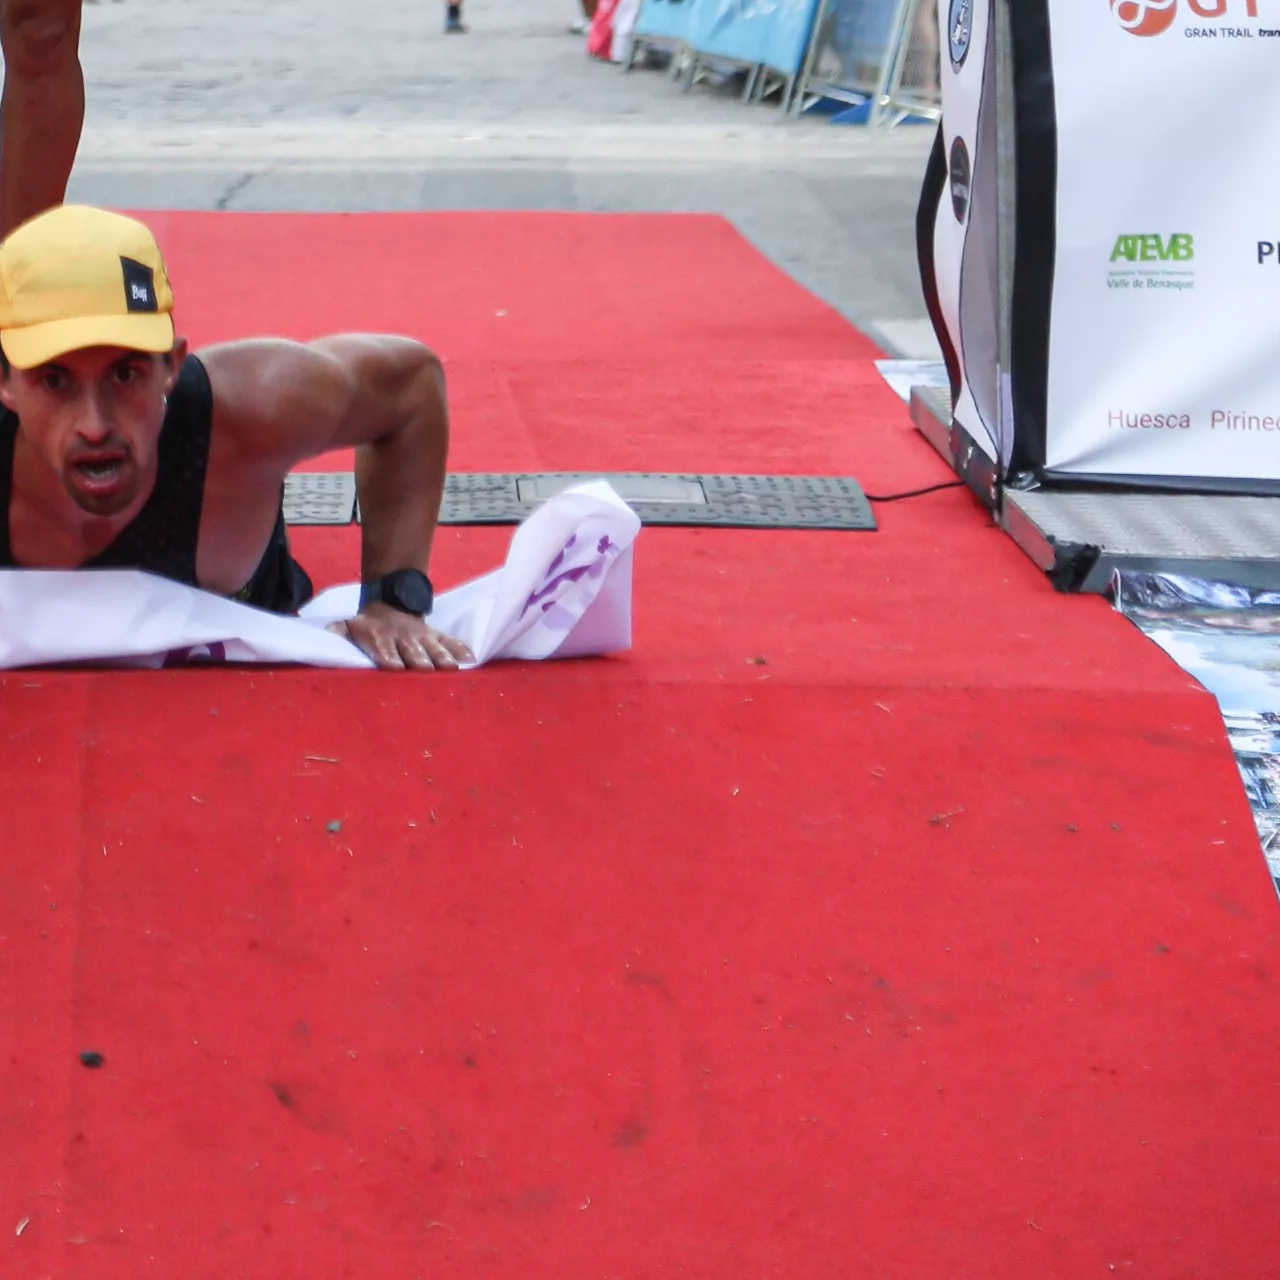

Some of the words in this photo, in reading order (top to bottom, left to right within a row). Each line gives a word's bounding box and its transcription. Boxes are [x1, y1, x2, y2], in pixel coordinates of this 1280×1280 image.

[1184, 28, 1218, 39] GRAN
[1220, 28, 1254, 39] TRAIL
[1107, 279, 1130, 289] Valle
[1133, 279, 1144, 289] de
[1147, 278, 1195, 291] Benasque
[1107, 409, 1191, 430] Huesca
